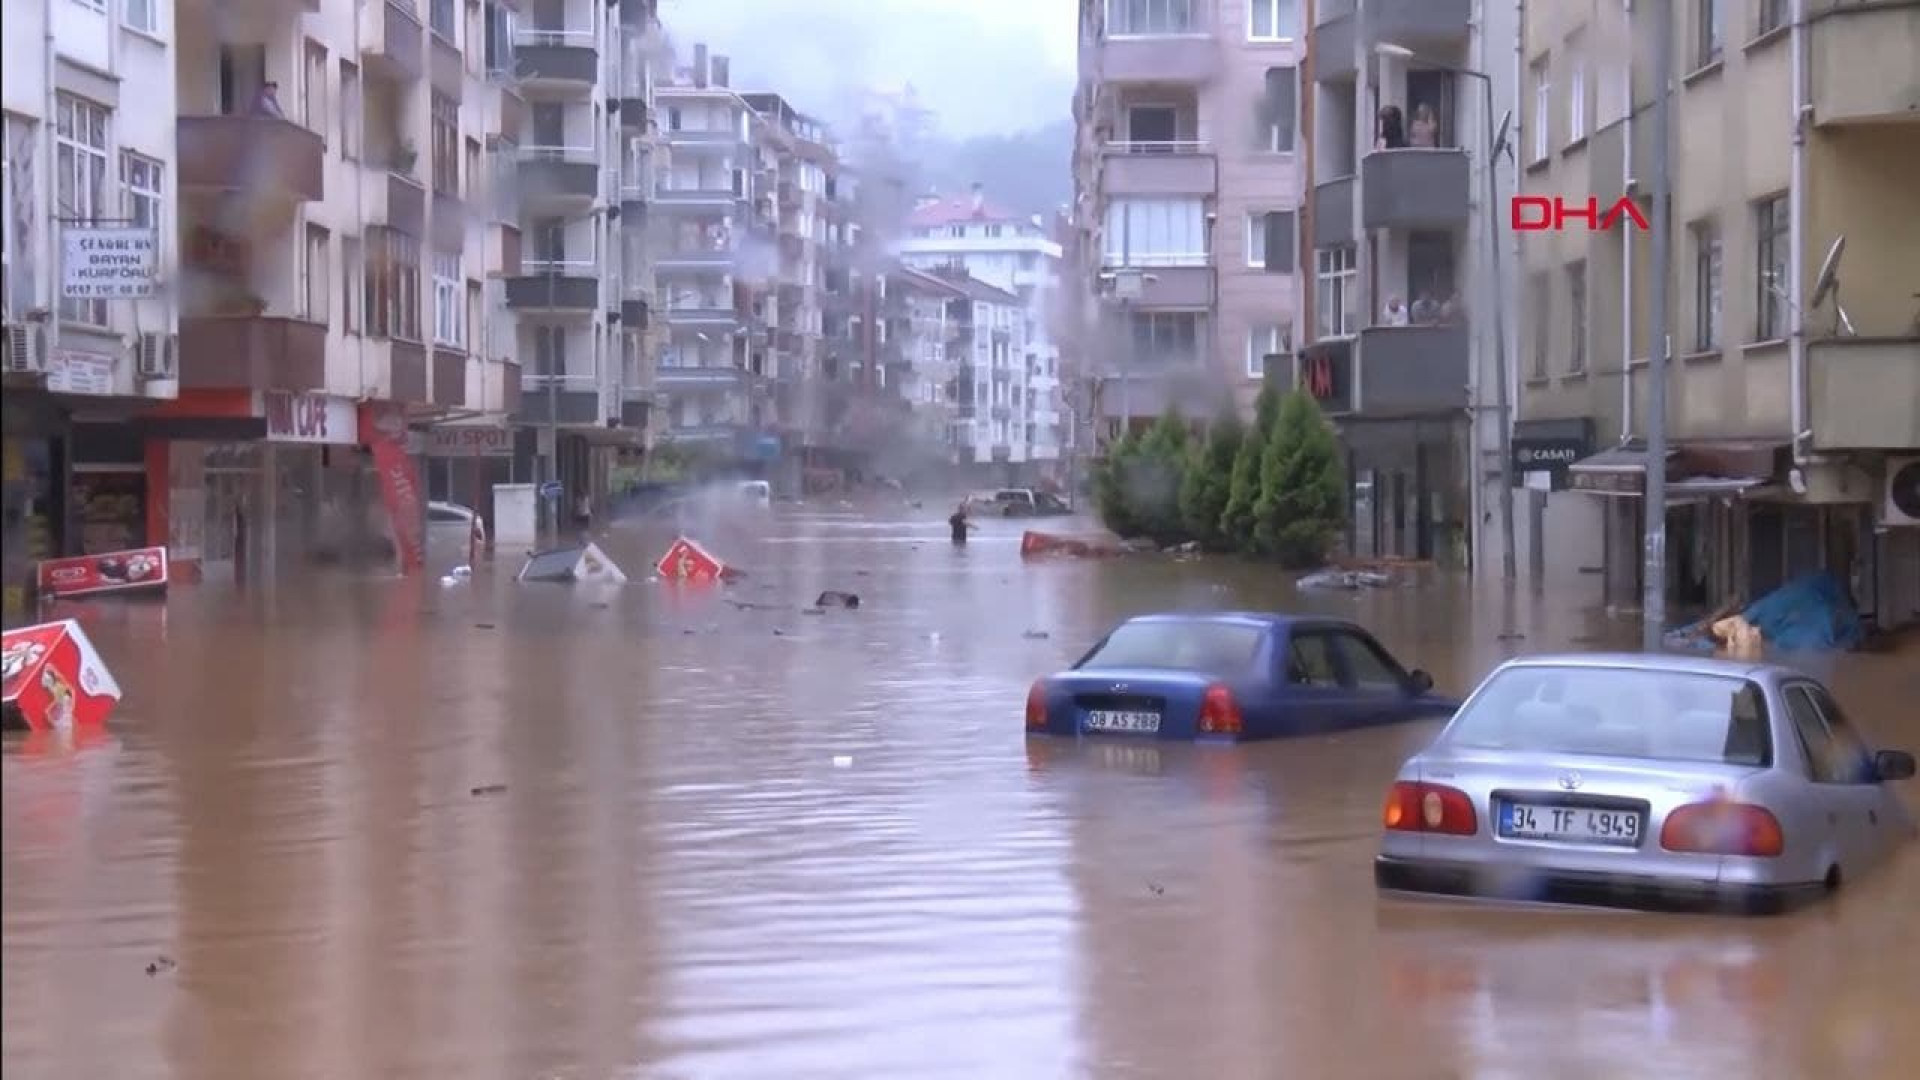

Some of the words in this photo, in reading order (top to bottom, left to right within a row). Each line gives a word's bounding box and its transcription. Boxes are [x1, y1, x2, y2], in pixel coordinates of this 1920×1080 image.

[89, 254, 141, 265] BAYAN
[1513, 806, 1537, 830] 34
[1551, 808, 1576, 832] TF
[1586, 812, 1637, 837] 4949
